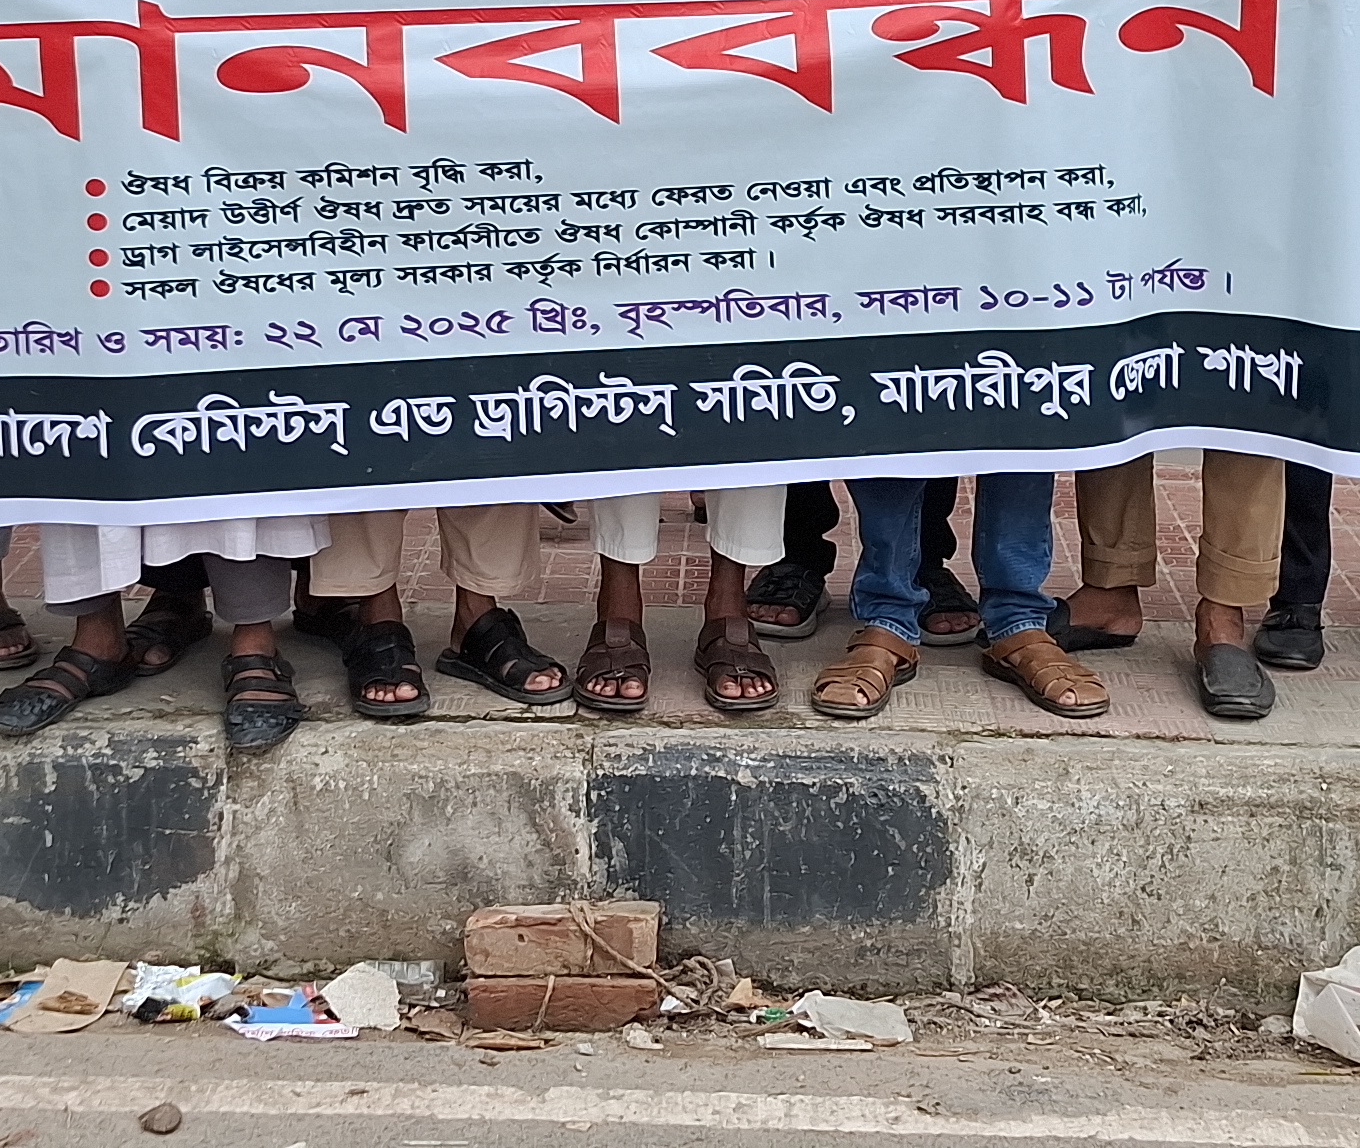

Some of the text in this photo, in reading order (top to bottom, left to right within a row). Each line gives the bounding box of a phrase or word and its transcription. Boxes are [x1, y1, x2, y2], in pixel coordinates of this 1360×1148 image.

[121, 158, 544, 196] ঔষধ বিক্রয় কমিশন বৃদ্ধি করা,
[122, 164, 1116, 232] মেয়াদ উত্তীর্ণ ঔষধ দ্রুত সময়ের মধ্যে ফেরত নেওয়া এবং প্রতিস্থাপন করা,
[119, 193, 1148, 270] ড্রাগ লাইসেন্সবিহীন ফার্মেসীতে ঔষধ কোম্পানী কর্তৃক ঔষধ সরবরাহ বন্ধ করা,
[96, 332, 126, 354] ও
[264, 321, 323, 350] ২২
[339, 316, 384, 343] মে
[400, 309, 516, 343] ২০২৫
[618, 289, 843, 340] বৃহস্পতিবার,
[855, 284, 962, 316] সকাল
[979, 281, 1094, 311] ১০-১১
[1106, 270, 1134, 302] টা
[1140, 257, 1209, 295] পর্যন্ত
[121, 278, 200, 301] সকল
[212, 269, 317, 295] ঔষধের
[324, 269, 386, 297] মূল্য
[393, 260, 495, 287] সরকার
[501, 253, 584, 289] কর্তৃক
[590, 248, 692, 277] নির্ধারন
[699, 248, 758, 271] করা
[130, 392, 351, 457] কেমিস্টস্
[370, 397, 457, 442] এন্ড
[469, 371, 679, 442] ড্রাগিস্টস্
[689, 362, 856, 426] সমিতি,
[870, 351, 1094, 420] মাদারীপুর
[1110, 341, 1185, 401] জেলা
[1200, 346, 1303, 400] শাখা
